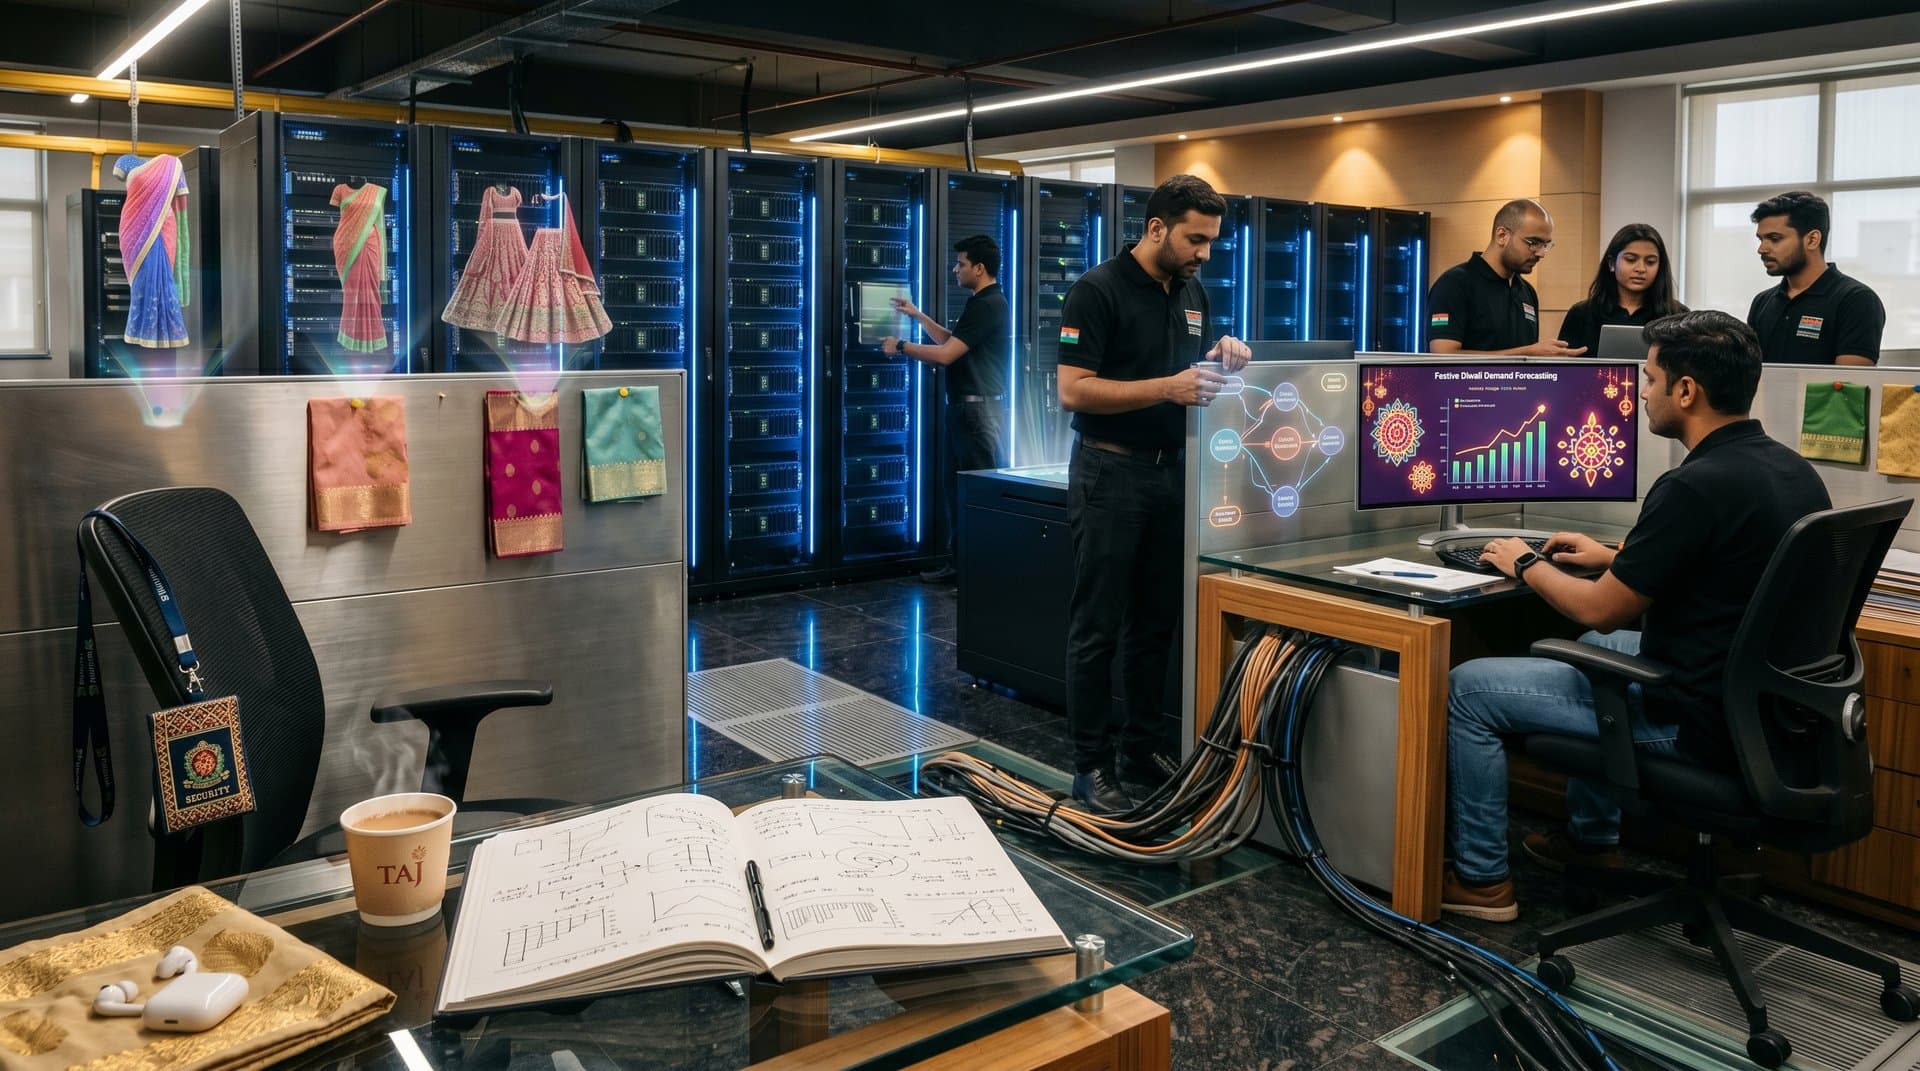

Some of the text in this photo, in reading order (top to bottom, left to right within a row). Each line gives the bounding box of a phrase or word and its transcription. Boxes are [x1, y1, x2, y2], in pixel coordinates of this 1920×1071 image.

[1435, 371, 1459, 380] Festive
[1461, 371, 1482, 380] Diwali
[1484, 371, 1513, 380] Demand
[185, 785, 231, 804] SECURITY
[376, 861, 424, 888] TAJ
